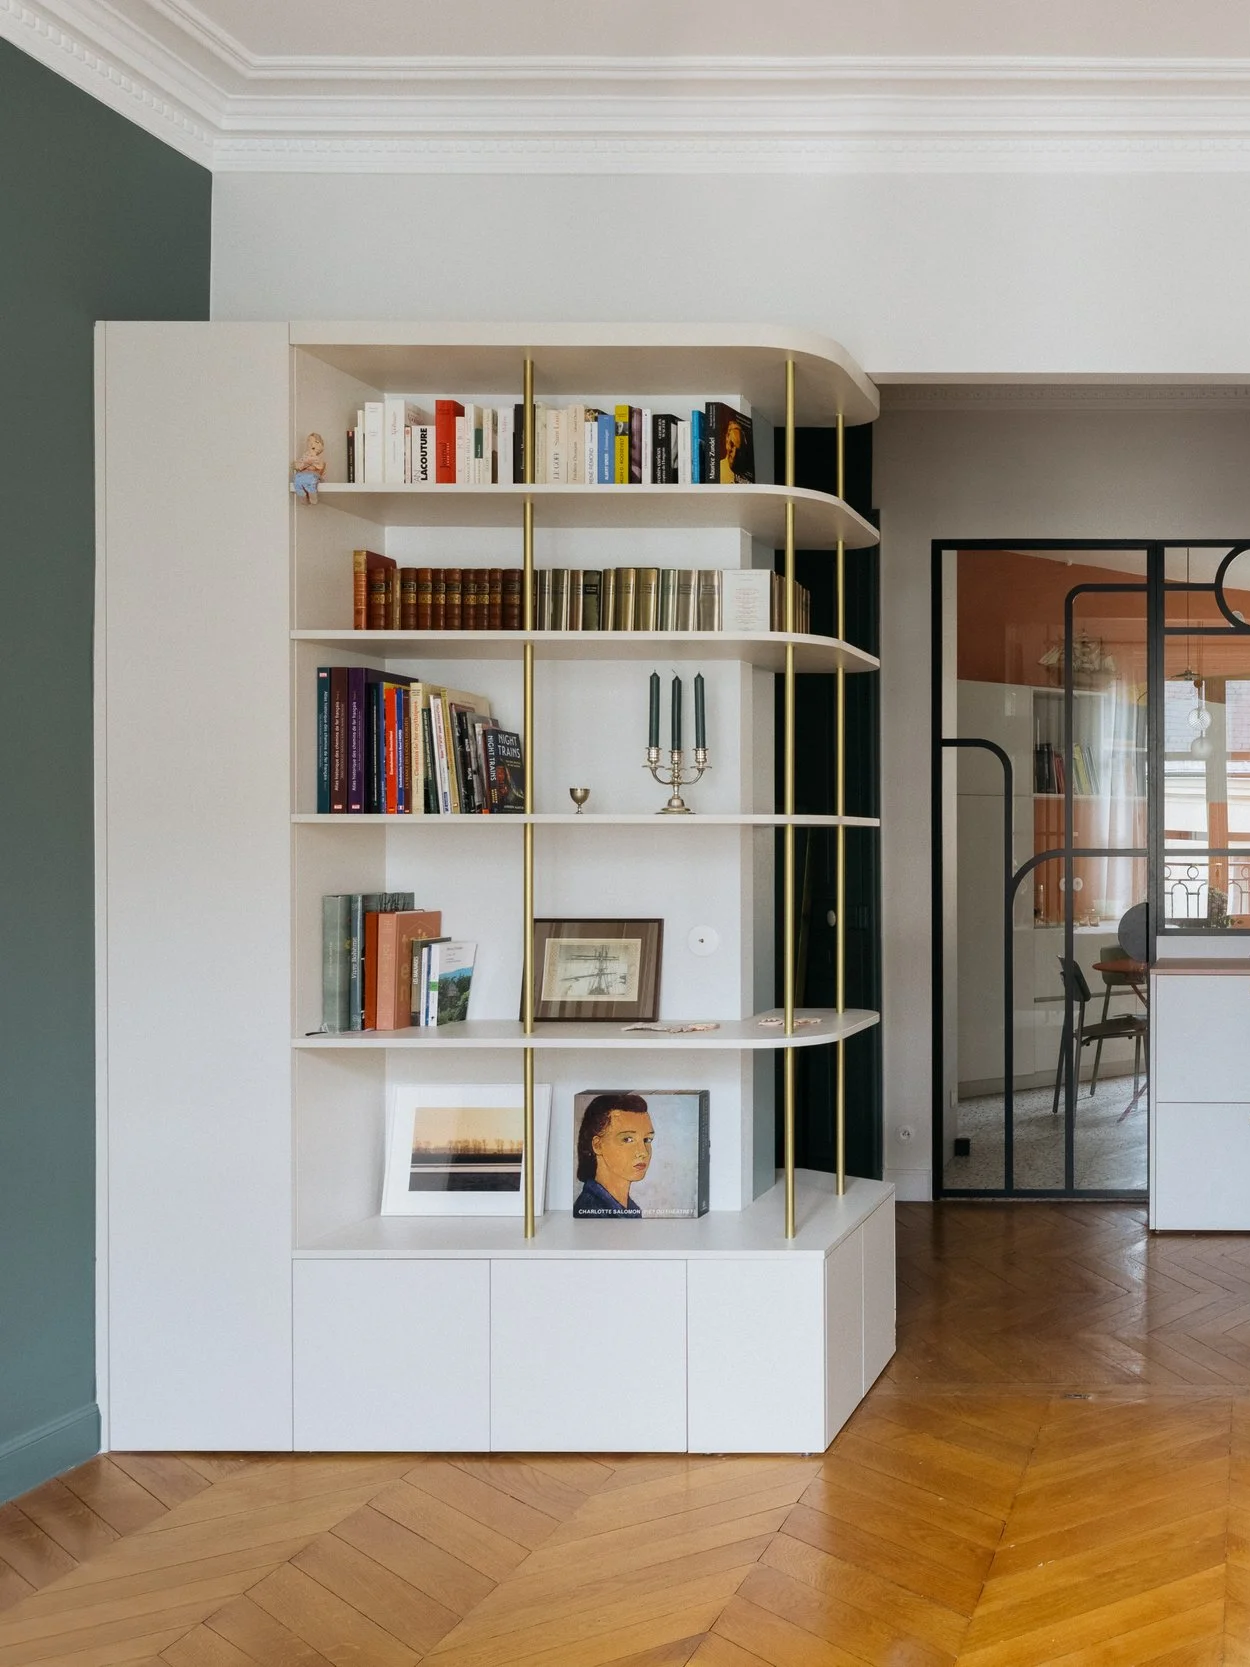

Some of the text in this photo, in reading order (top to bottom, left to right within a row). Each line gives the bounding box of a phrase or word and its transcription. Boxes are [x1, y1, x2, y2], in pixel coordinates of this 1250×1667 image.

[420, 427, 428, 481] LACOUTURE
[498, 734, 517, 746] NIGHT
[498, 745, 521, 759] TRAINS
